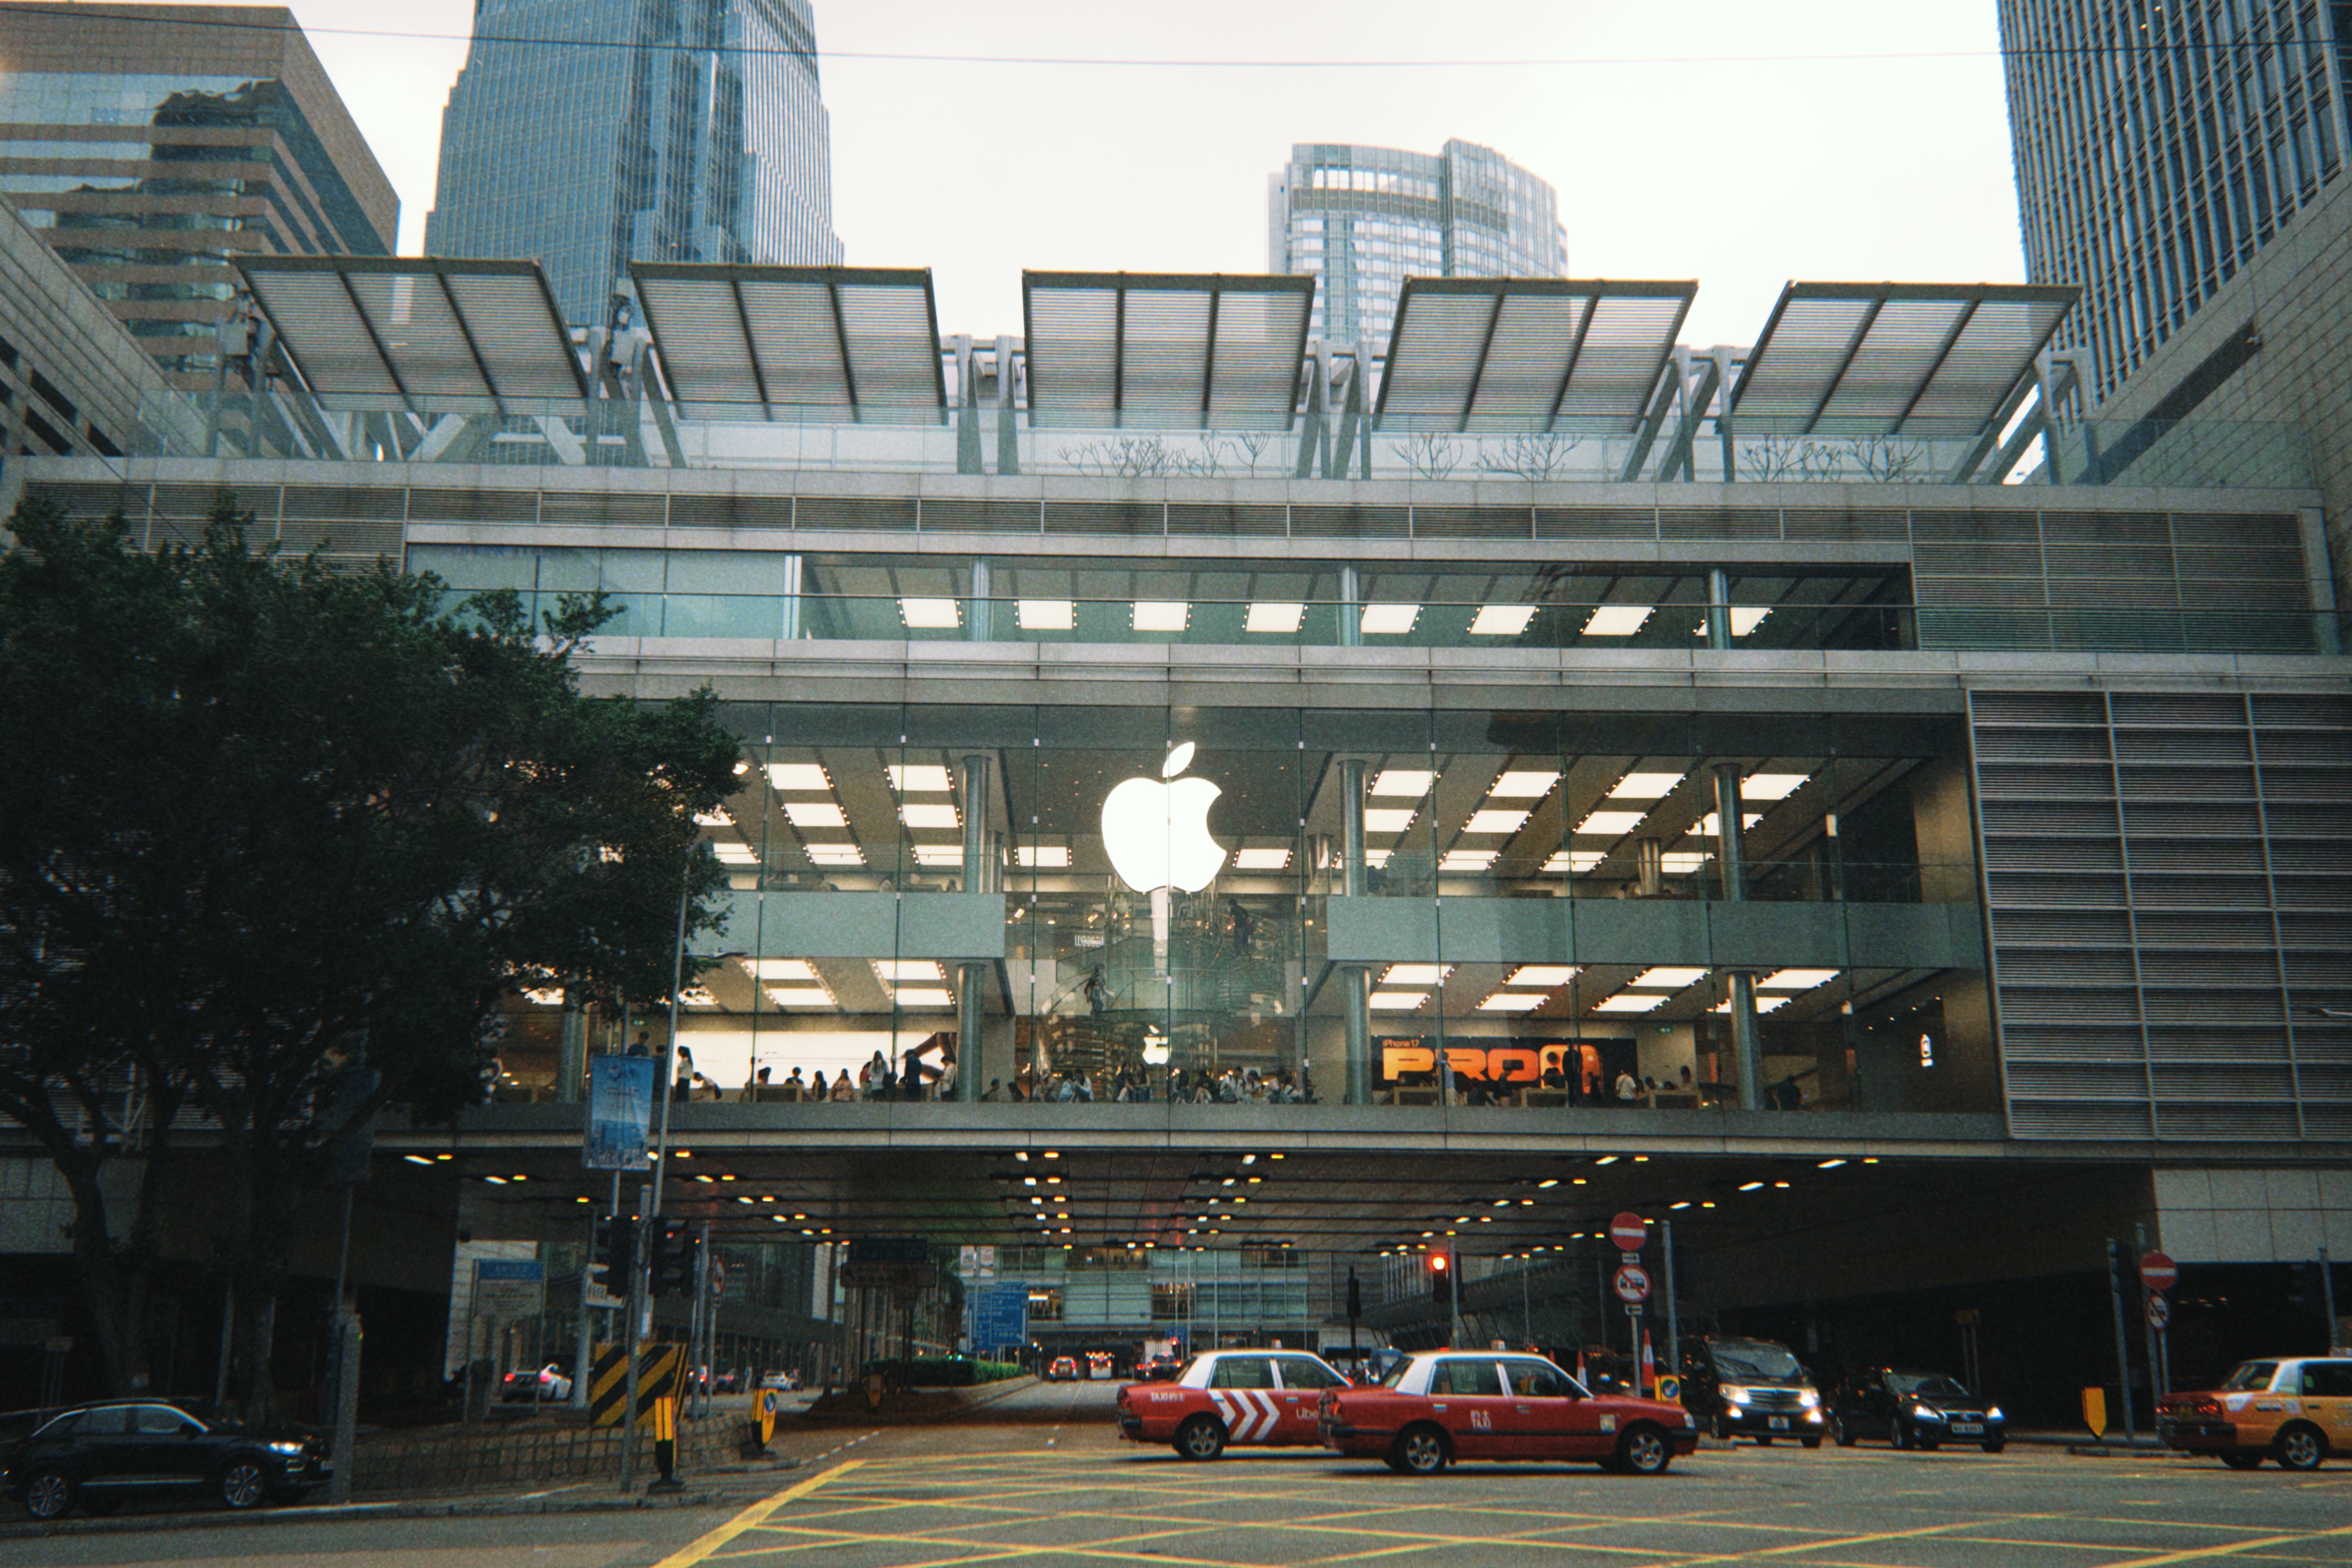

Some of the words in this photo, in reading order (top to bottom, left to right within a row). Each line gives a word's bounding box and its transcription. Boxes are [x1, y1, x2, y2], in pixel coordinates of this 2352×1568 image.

[1382, 1039, 1410, 1047] iPhone
[1411, 1039, 1420, 1047] 17
[1383, 1047, 1538, 1082] PRO
[1296, 1407, 1319, 1420] Ube
[1472, 1418, 1491, 1430] TAXI
